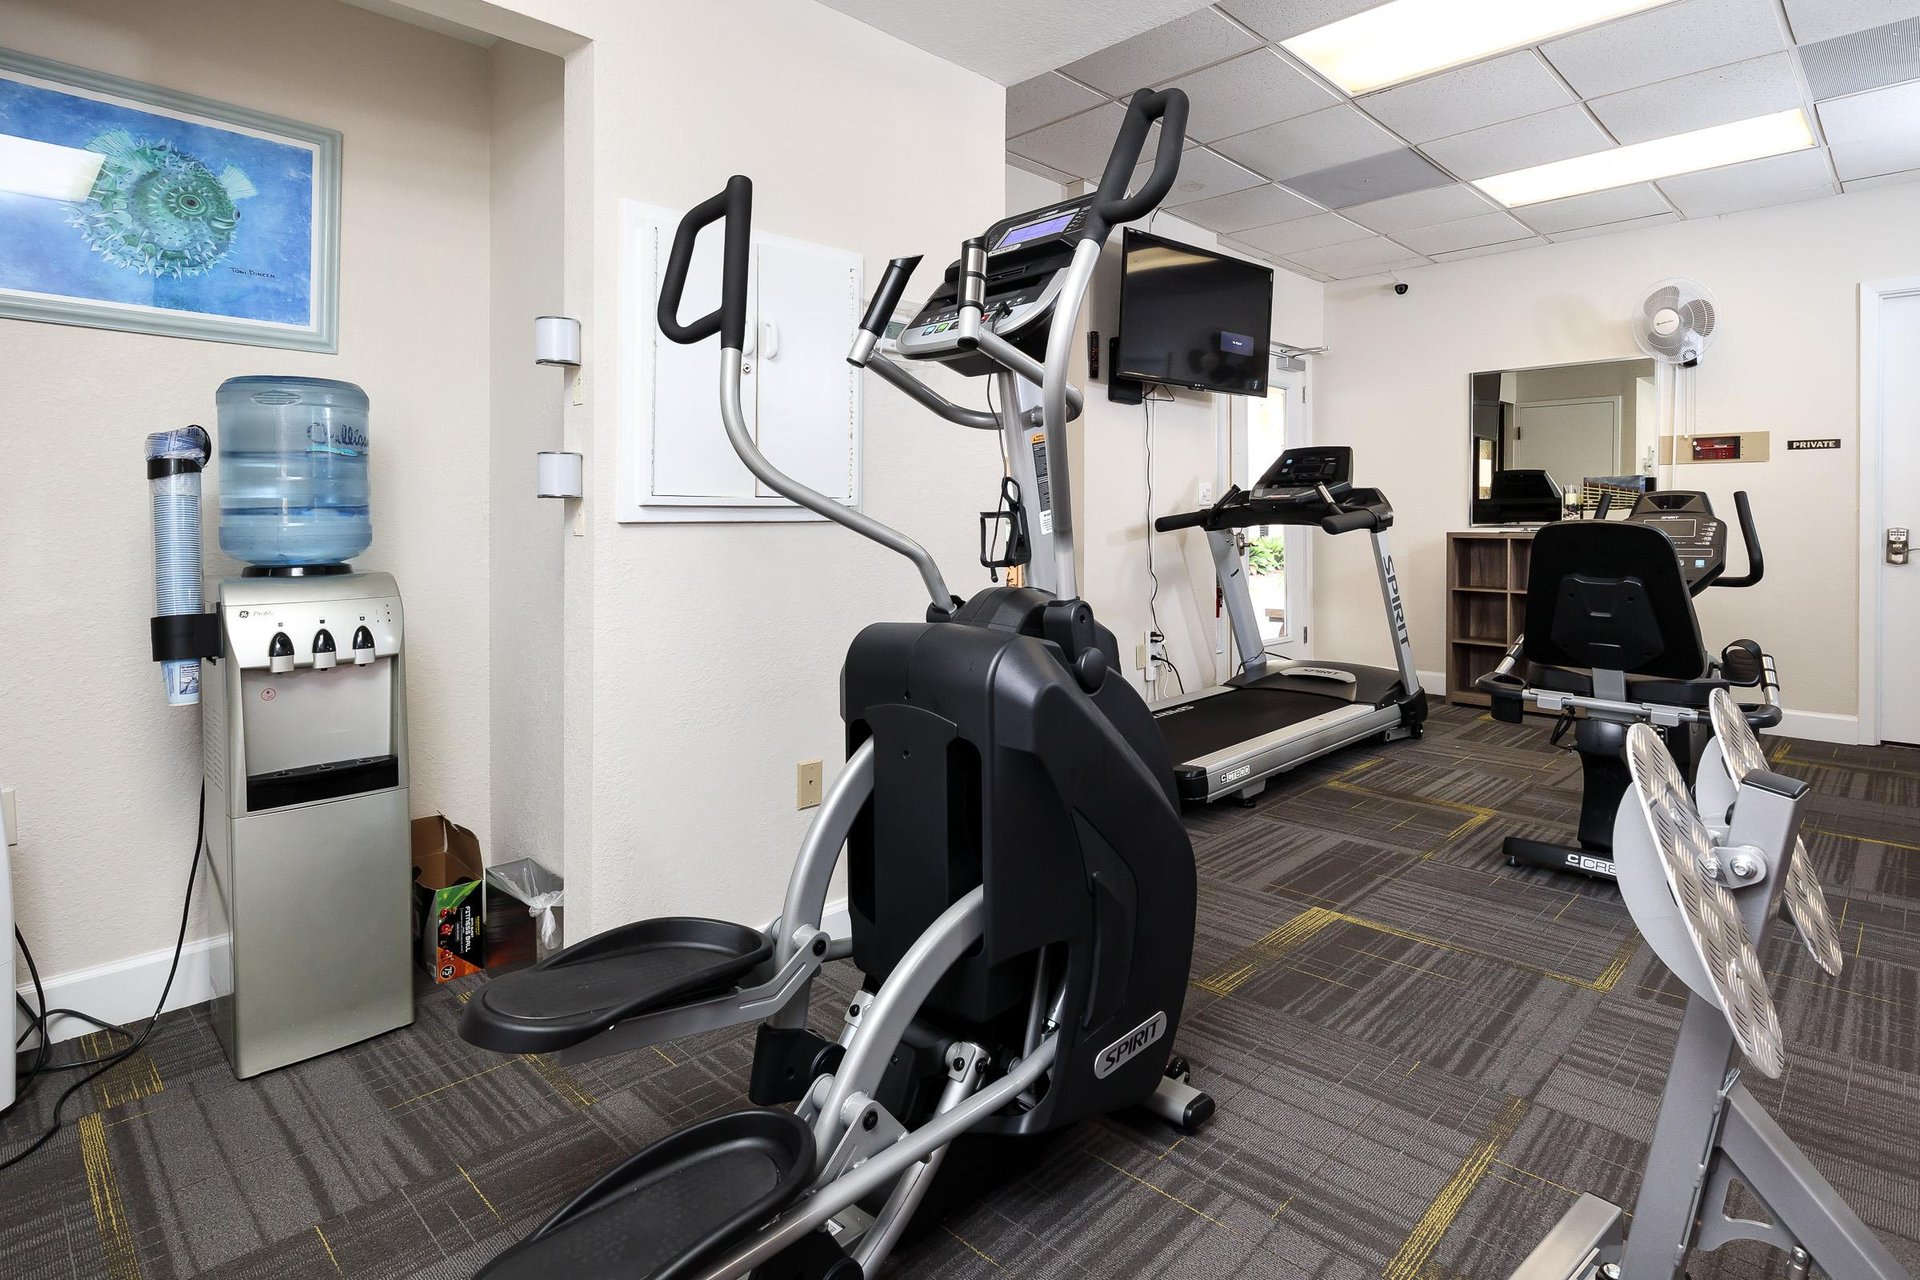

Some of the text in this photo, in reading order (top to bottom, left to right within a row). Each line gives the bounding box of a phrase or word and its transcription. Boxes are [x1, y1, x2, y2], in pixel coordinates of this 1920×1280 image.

[1793, 440, 1836, 449] PRIVATE
[1383, 554, 1411, 648] SPIRIT
[1583, 857, 1617, 875] CR8
[1103, 1018, 1161, 1073] SPIRIT
